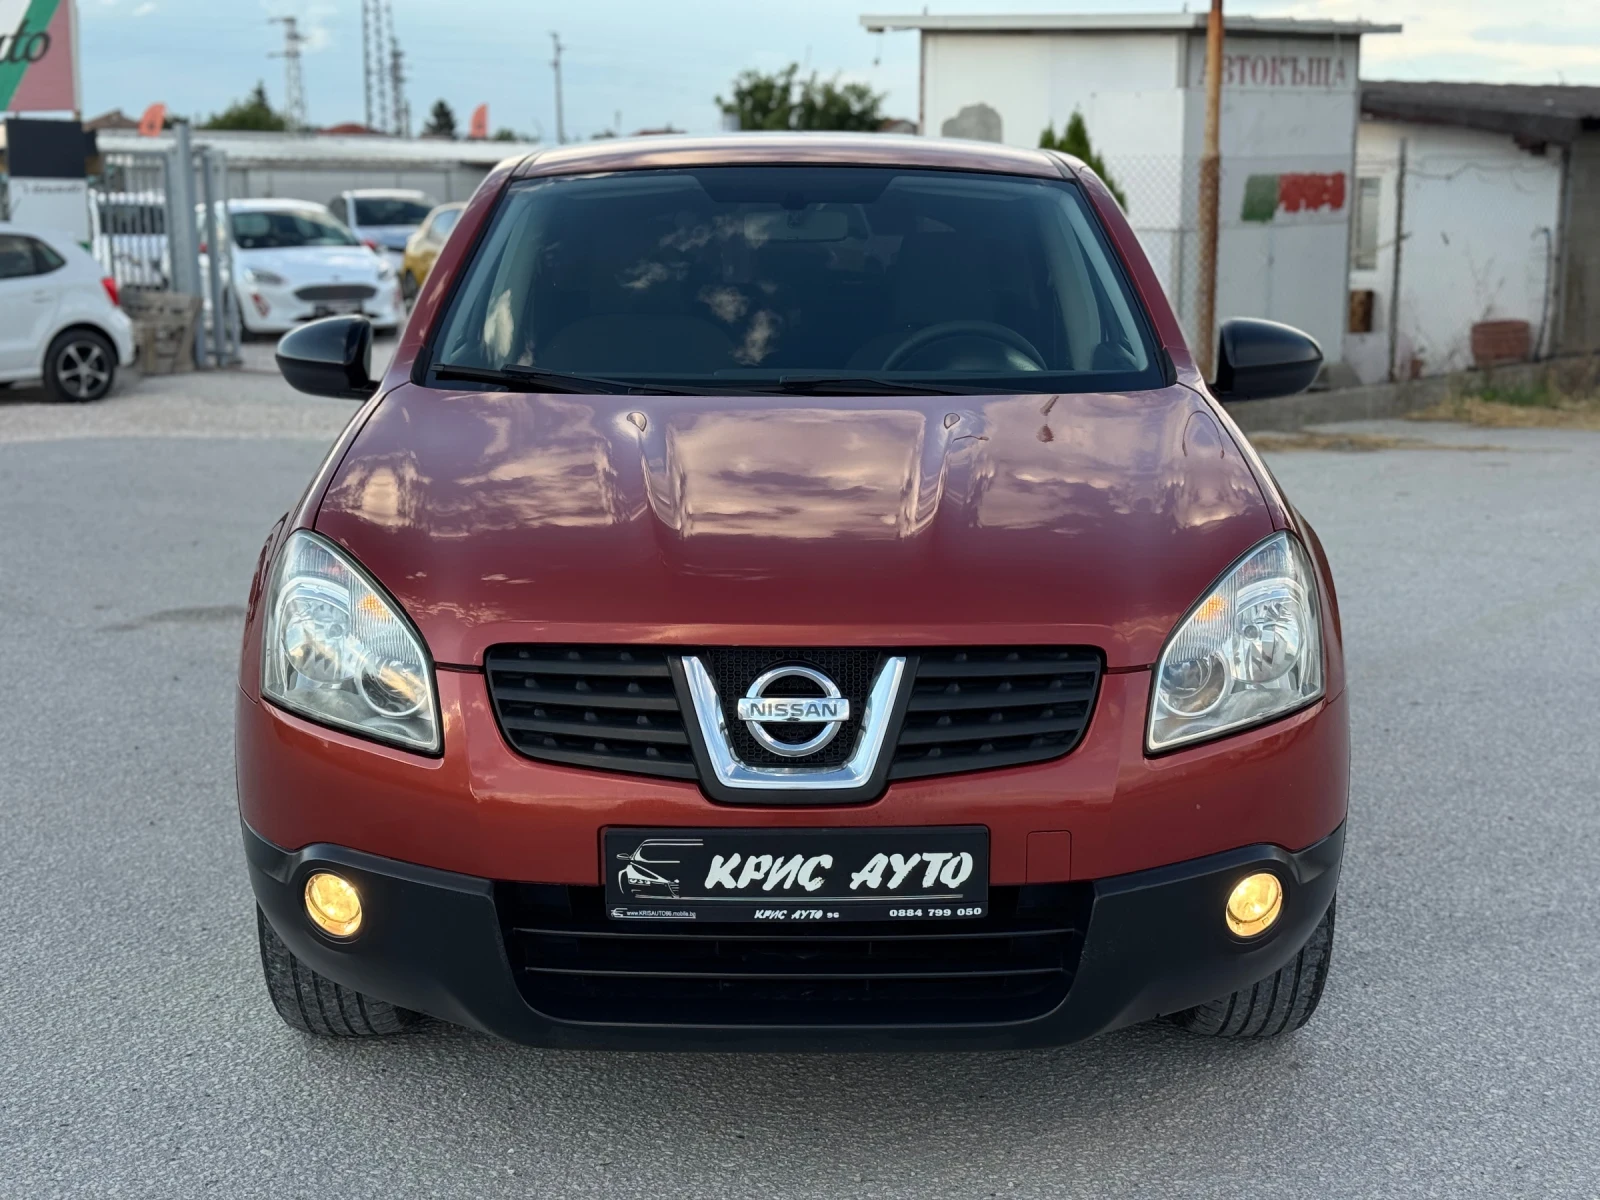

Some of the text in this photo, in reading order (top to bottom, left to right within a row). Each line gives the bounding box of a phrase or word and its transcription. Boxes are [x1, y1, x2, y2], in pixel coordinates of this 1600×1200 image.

[0, 18, 51, 64] to
[750, 703, 838, 717] NISSAN
[704, 852, 973, 892] КРИС АУТО
[754, 909, 788, 920] КРИС
[791, 909, 823, 920] АУТО
[889, 907, 982, 917] 0884 799 050
